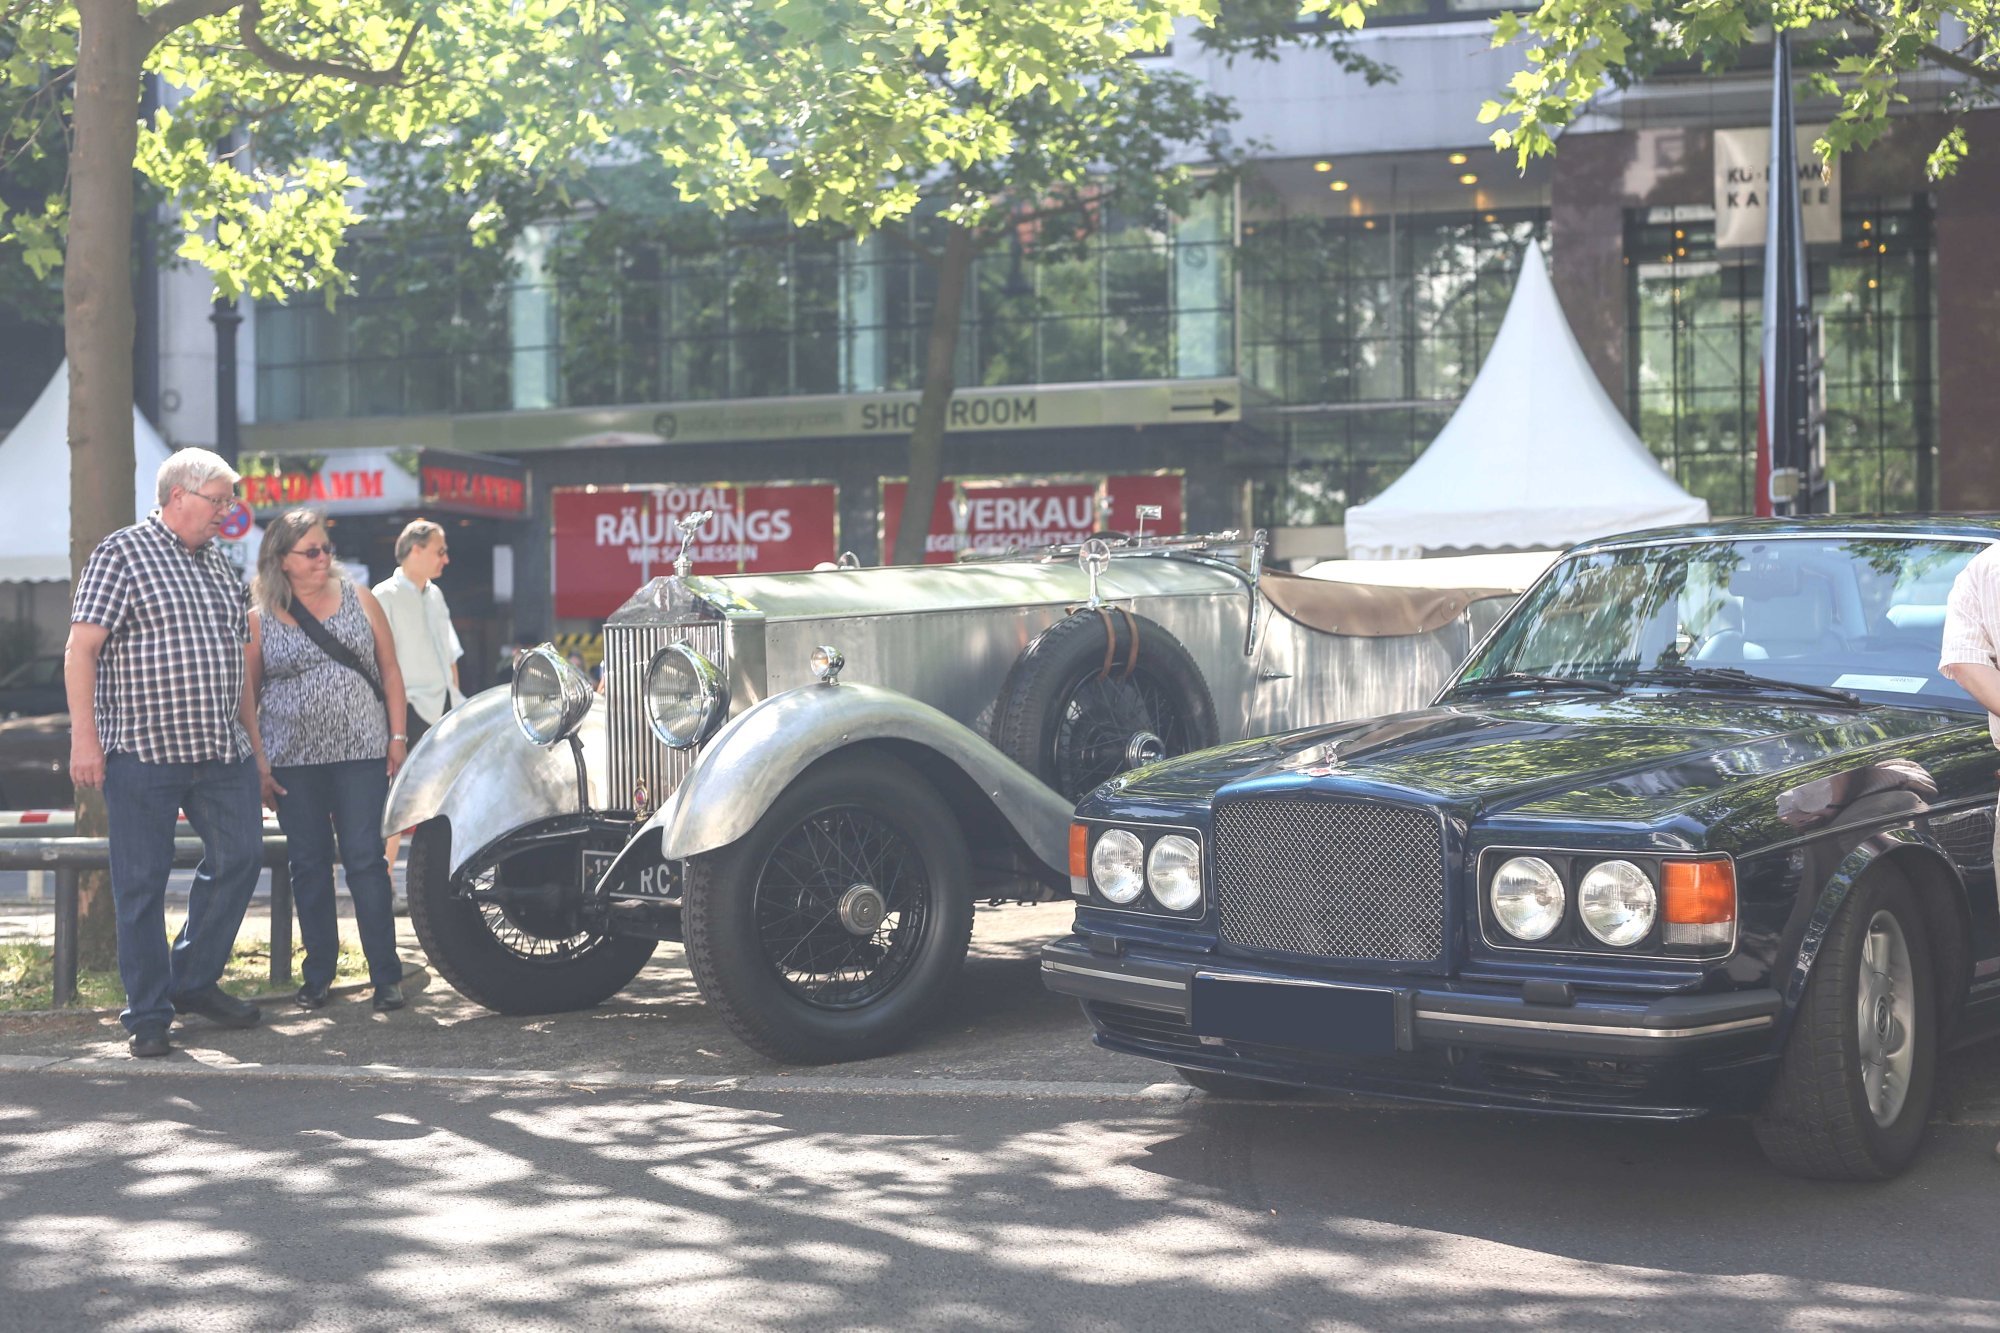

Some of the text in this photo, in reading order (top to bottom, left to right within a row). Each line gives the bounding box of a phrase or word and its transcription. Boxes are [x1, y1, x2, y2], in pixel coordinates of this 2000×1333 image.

[1728, 187, 1830, 207] KAEE
[861, 397, 1038, 430] SHOROOM
[239, 469, 384, 502] ENDAMM
[653, 487, 732, 512] TOTAL
[948, 496, 1114, 531] VERKAUF
[926, 533, 973, 552] EGEN
